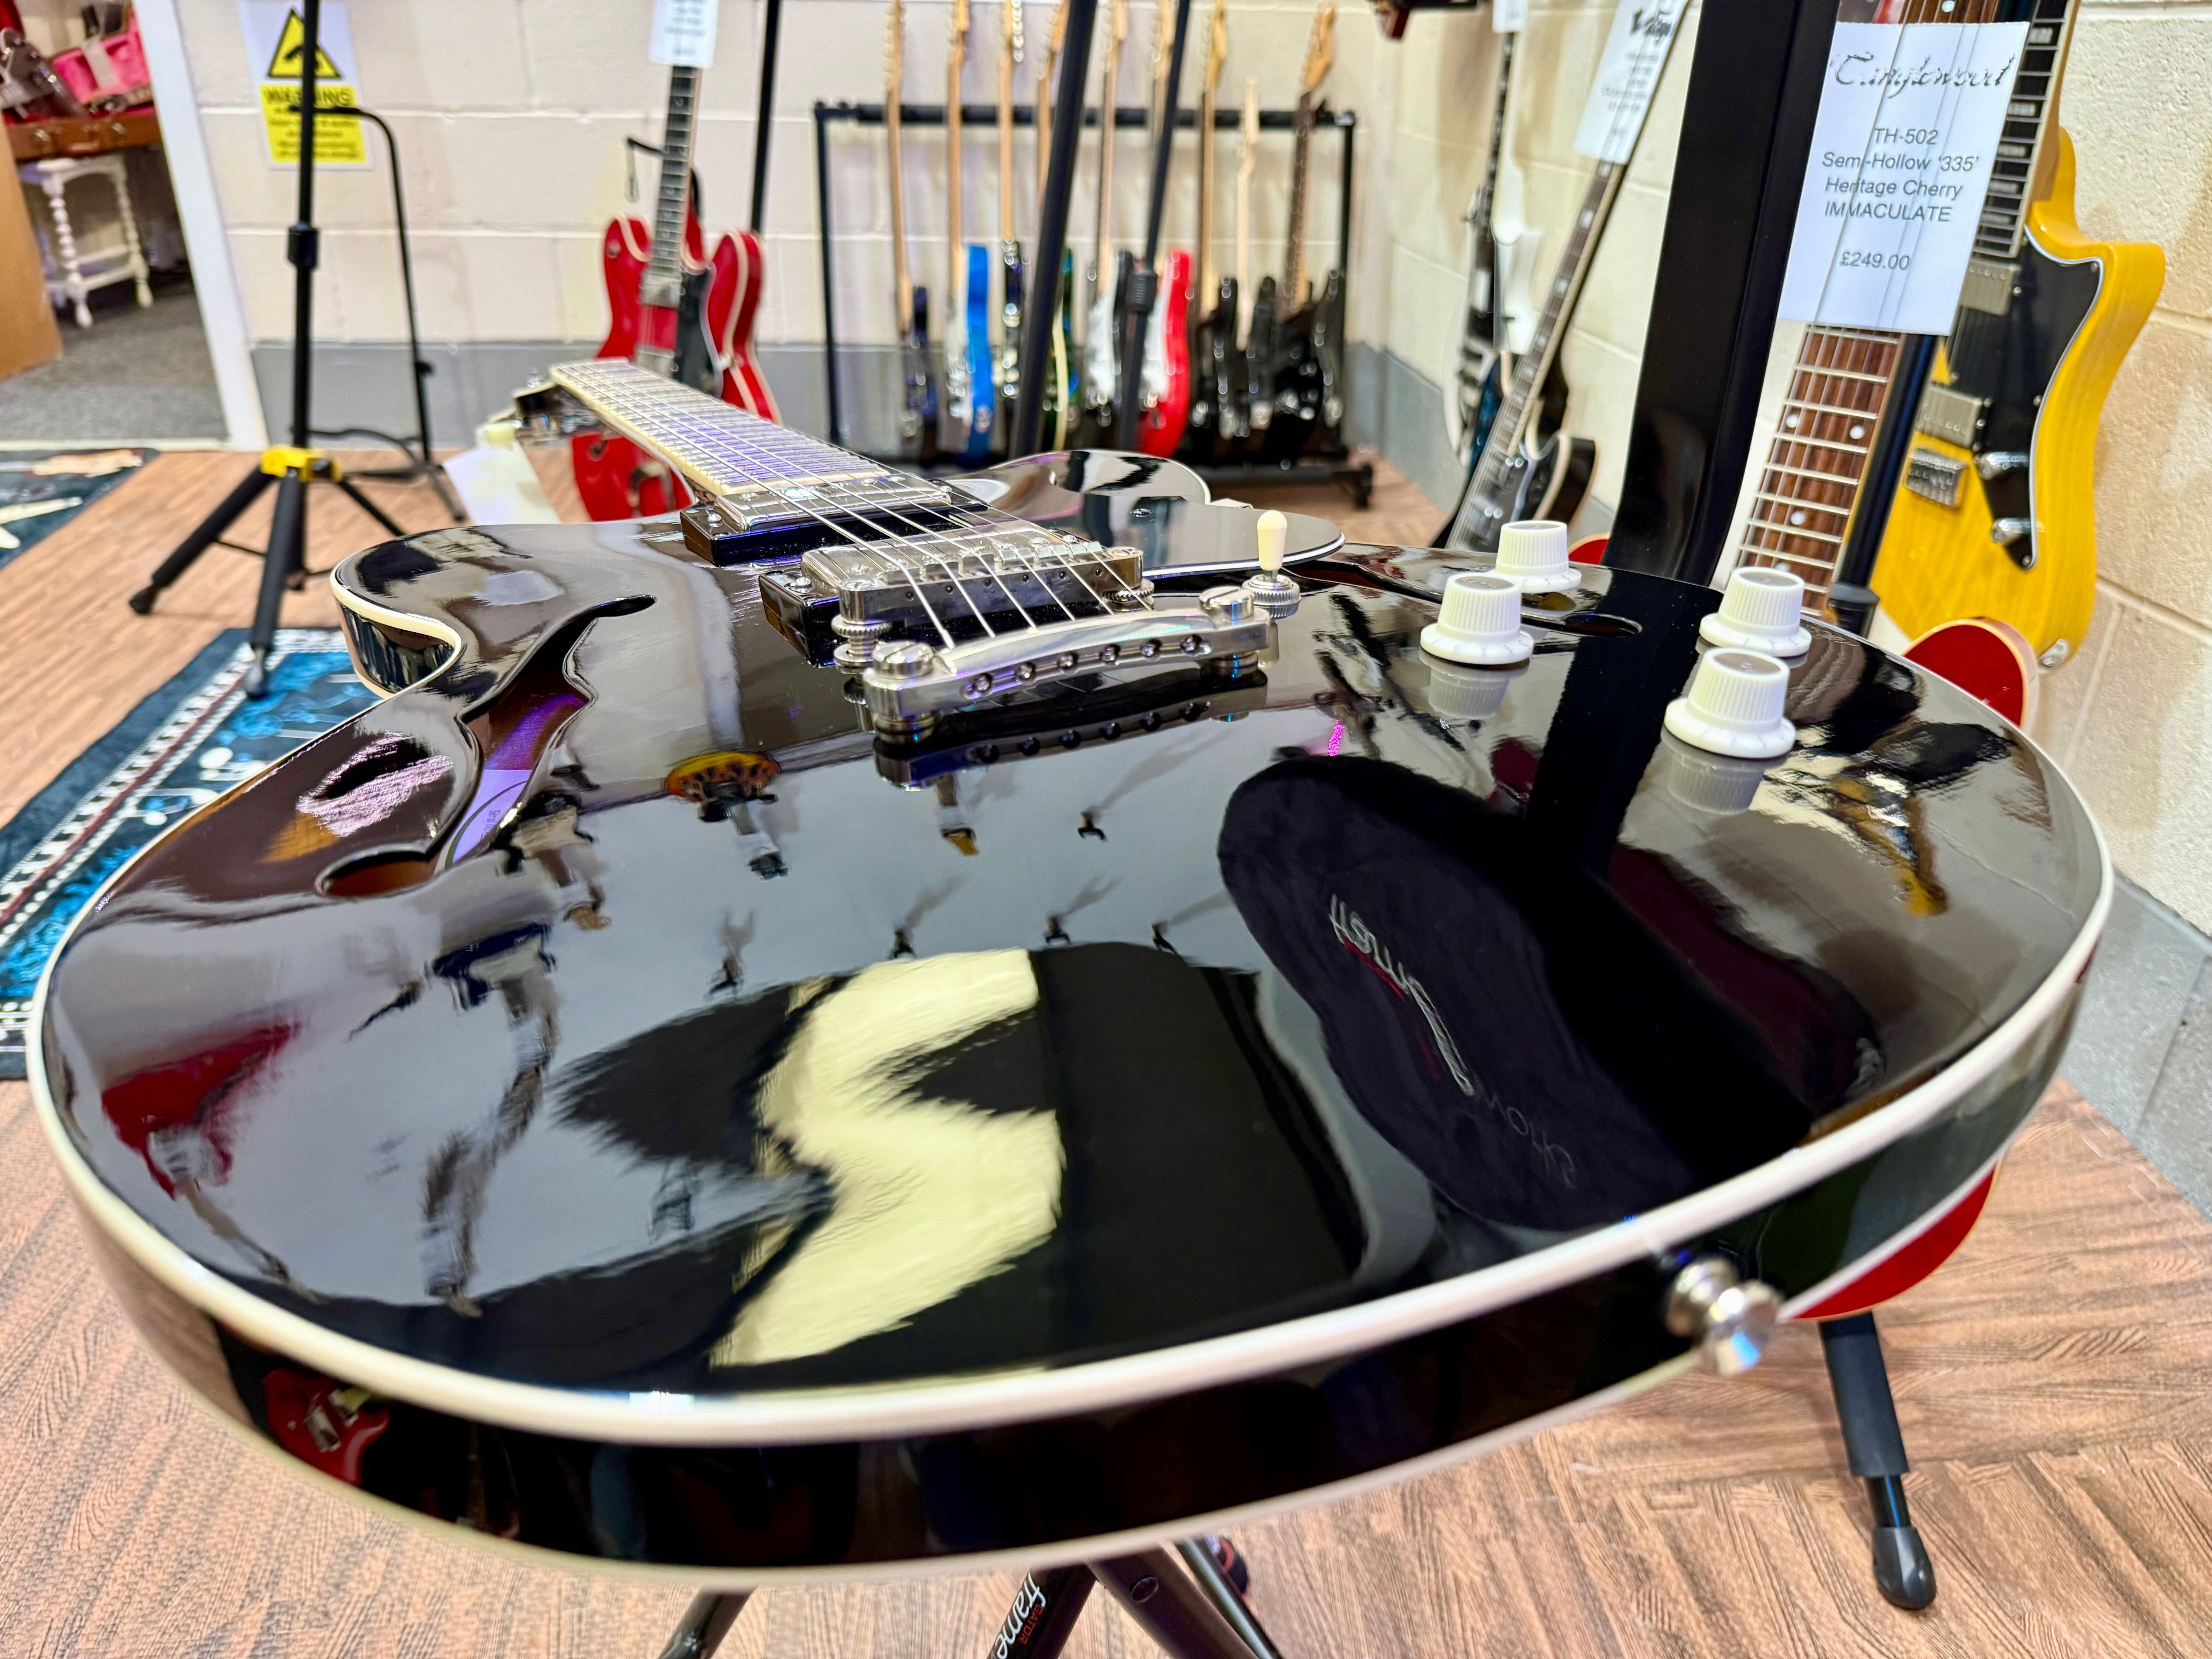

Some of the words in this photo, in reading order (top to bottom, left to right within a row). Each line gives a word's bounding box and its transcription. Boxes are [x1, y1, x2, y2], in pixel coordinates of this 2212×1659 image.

[1874, 128, 1938, 145] TH-502
[1822, 152, 1931, 170] Sem-Hollow
[1825, 177, 1897, 197] Heritage
[1903, 179, 1963, 201] Cherry
[1825, 201, 1952, 222] IMMACULATE
[1839, 251, 1910, 270] £249.00
[1019, 1603, 1044, 1644] GATOR
